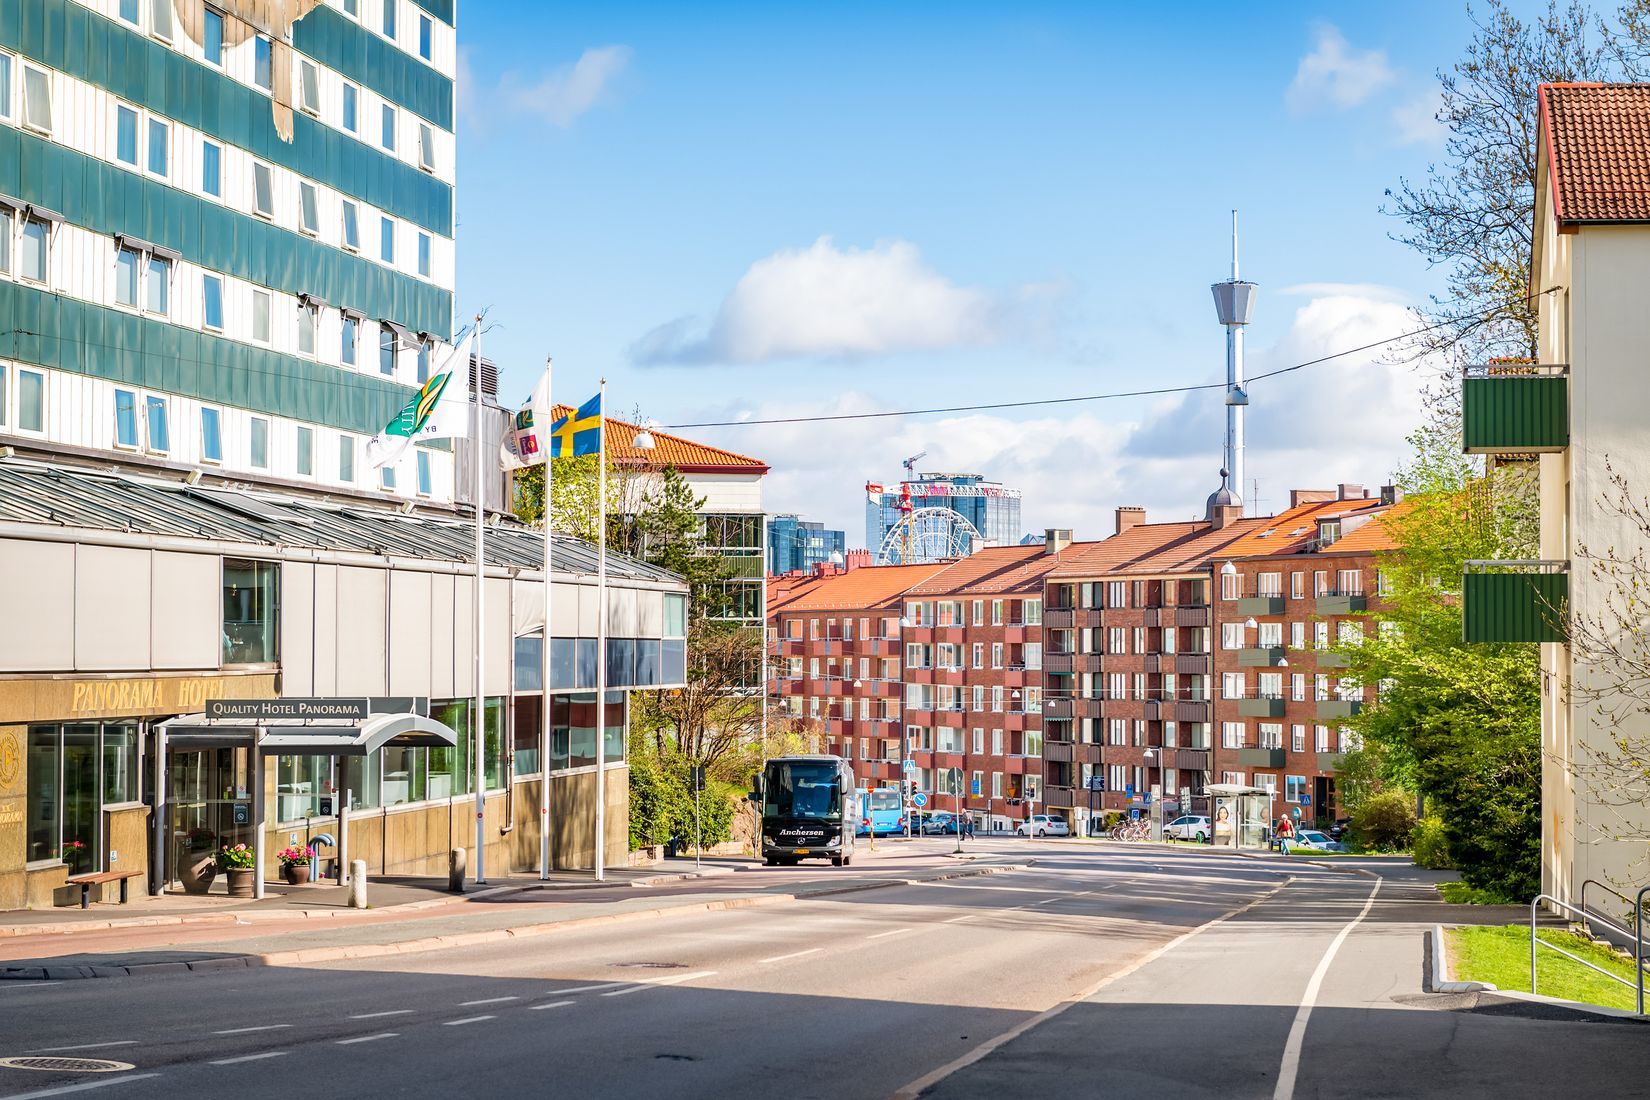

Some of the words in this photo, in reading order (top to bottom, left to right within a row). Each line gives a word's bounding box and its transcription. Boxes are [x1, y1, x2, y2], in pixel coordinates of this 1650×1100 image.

[72, 680, 165, 712] PANORAMA
[212, 702, 259, 717] QUALITY
[261, 702, 296, 715] HOTEL
[299, 702, 360, 715] PANORAMA
